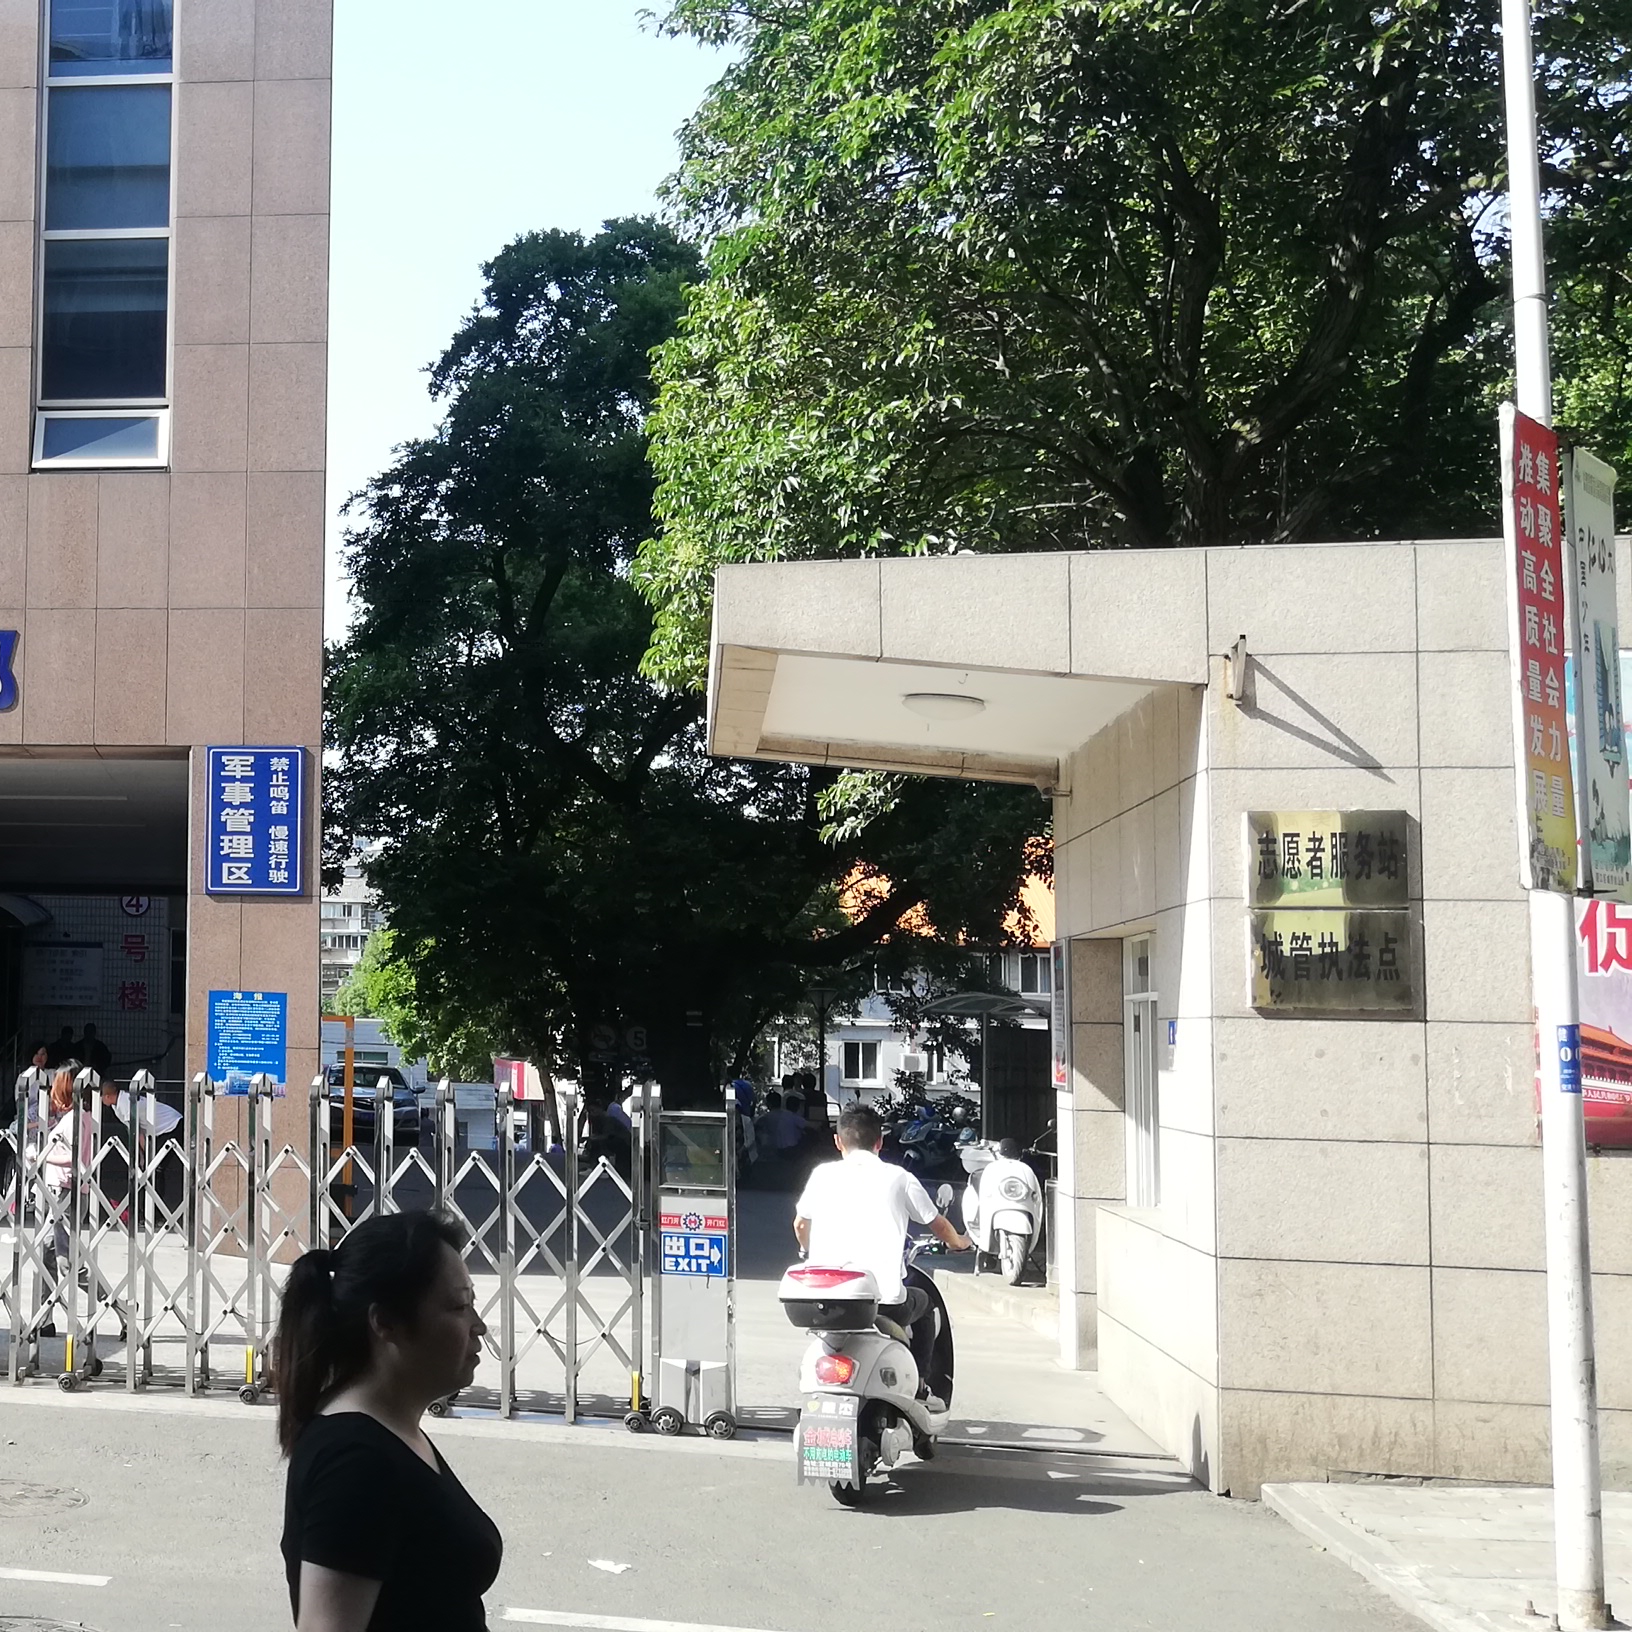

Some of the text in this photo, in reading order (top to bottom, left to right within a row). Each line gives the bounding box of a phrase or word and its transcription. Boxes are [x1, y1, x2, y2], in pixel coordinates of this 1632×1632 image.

[1518, 441, 1548, 814] 推动高质量发展
[1536, 452, 1566, 818] 集聚全社会力量
[220, 755, 255, 884] 军事管理区
[268, 757, 289, 883] 禁止鸣笛 慢速行驶
[1257, 831, 1399, 880] 志愿者服务站
[1261, 931, 1401, 981] 城管执法点
[664, 1236, 710, 1256] 出口
[664, 1257, 710, 1272] EXIT
